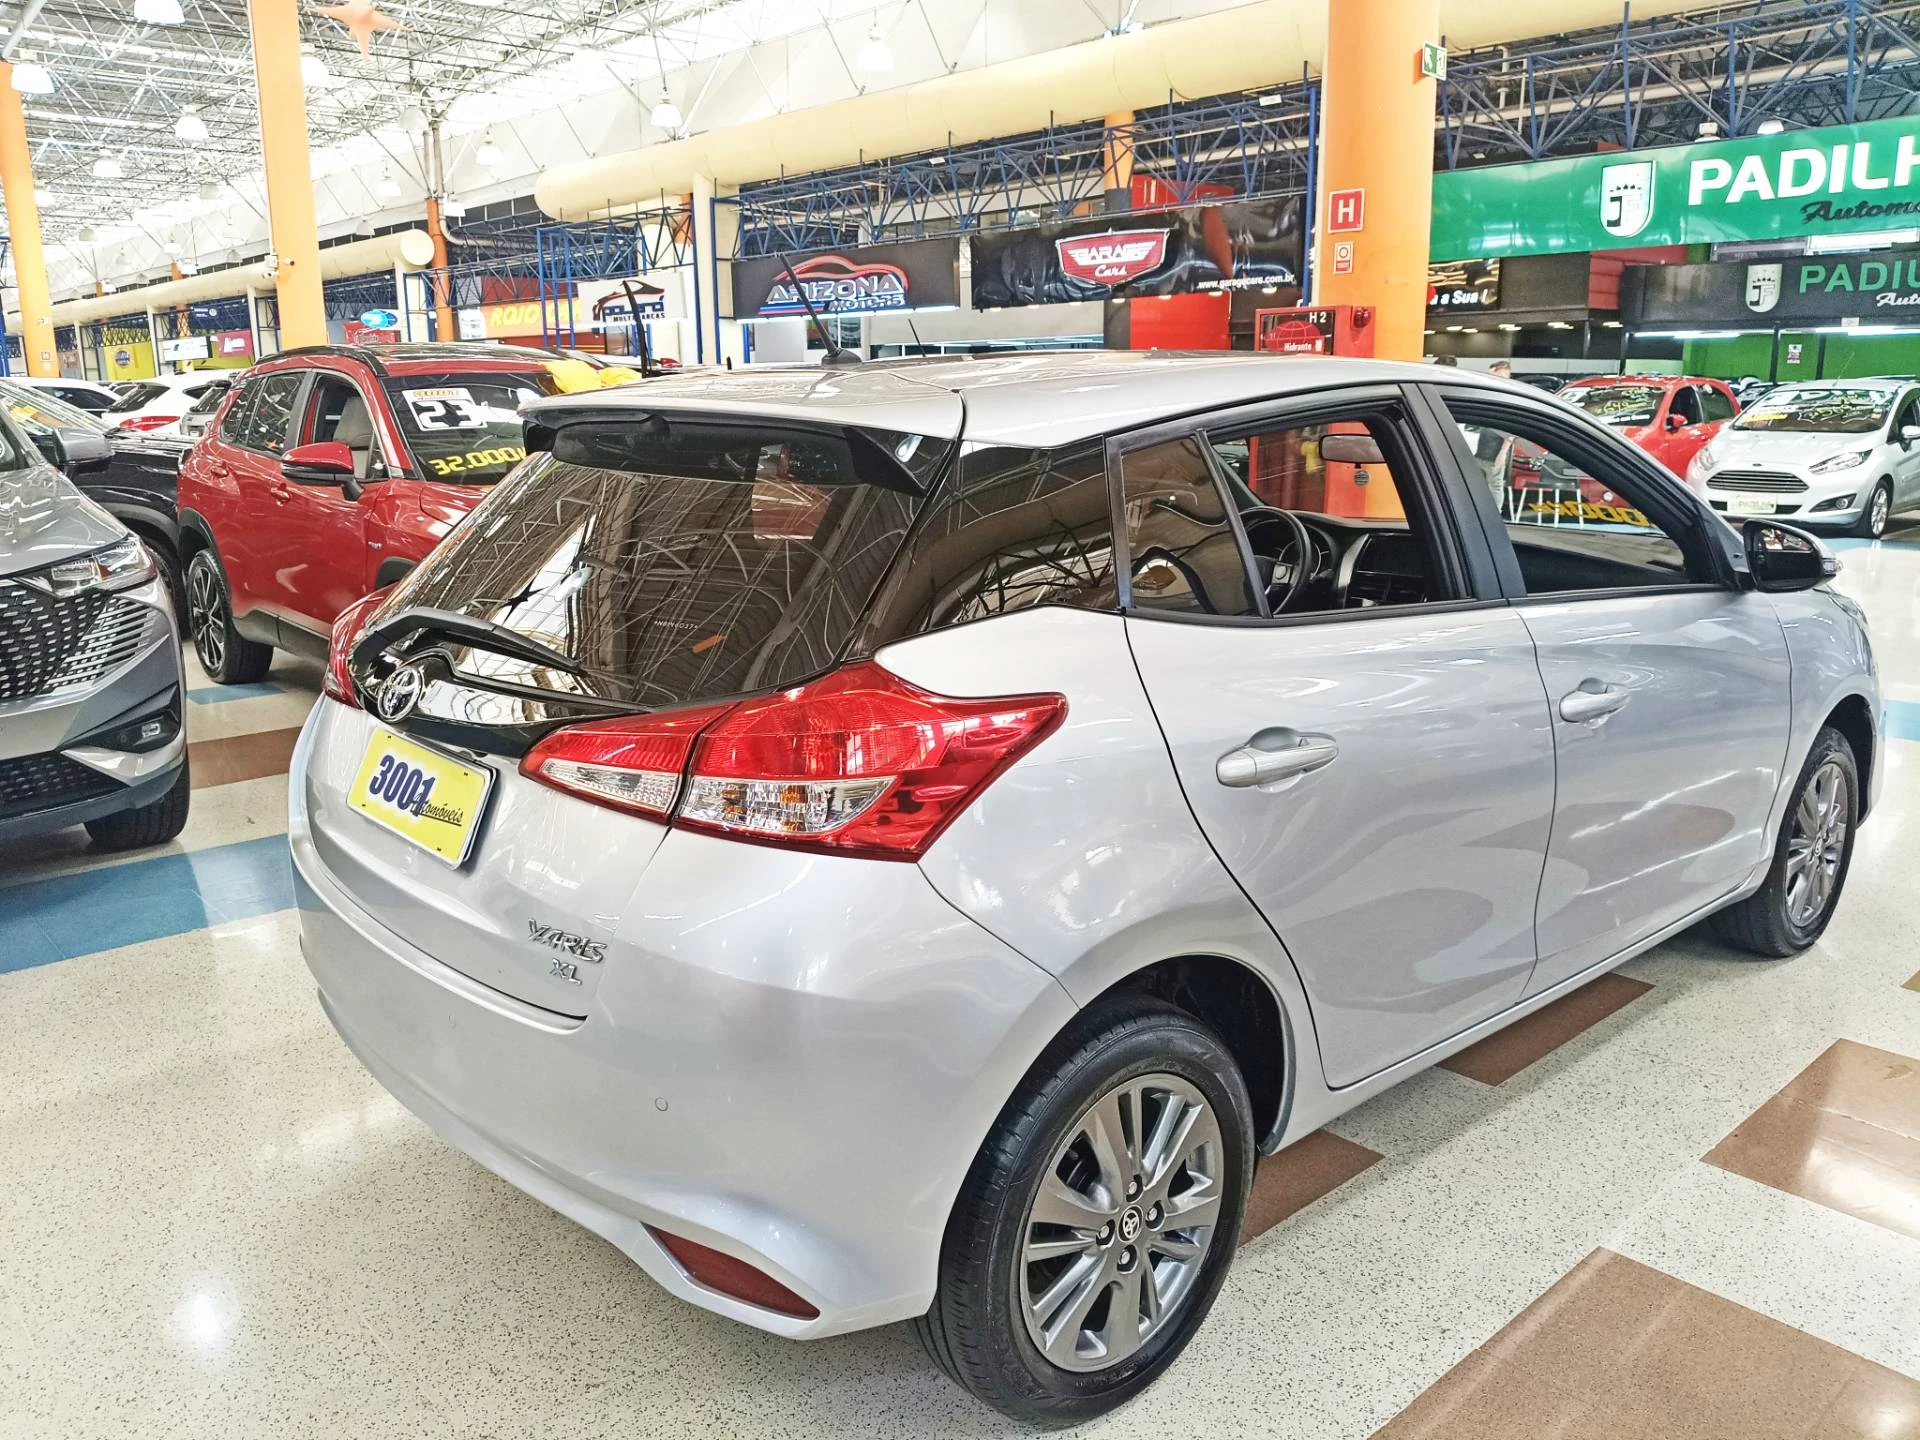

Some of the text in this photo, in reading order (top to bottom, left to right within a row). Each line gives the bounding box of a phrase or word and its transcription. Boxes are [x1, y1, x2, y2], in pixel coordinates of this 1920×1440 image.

[1337, 198, 1355, 224] H
[1095, 264, 1128, 277] Cars
[766, 273, 905, 304] ARIZONA
[1452, 290, 1479, 305] Sua
[490, 303, 541, 327] ROJO
[828, 294, 905, 312] MOTORS
[613, 312, 666, 322] MULTIARCAS
[1309, 312, 1327, 323] H 2
[1284, 342, 1312, 352] Hidrante
[415, 400, 485, 428] 23
[369, 754, 436, 817] 3001
[528, 918, 608, 963] YARIS
[549, 958, 582, 985] XL
